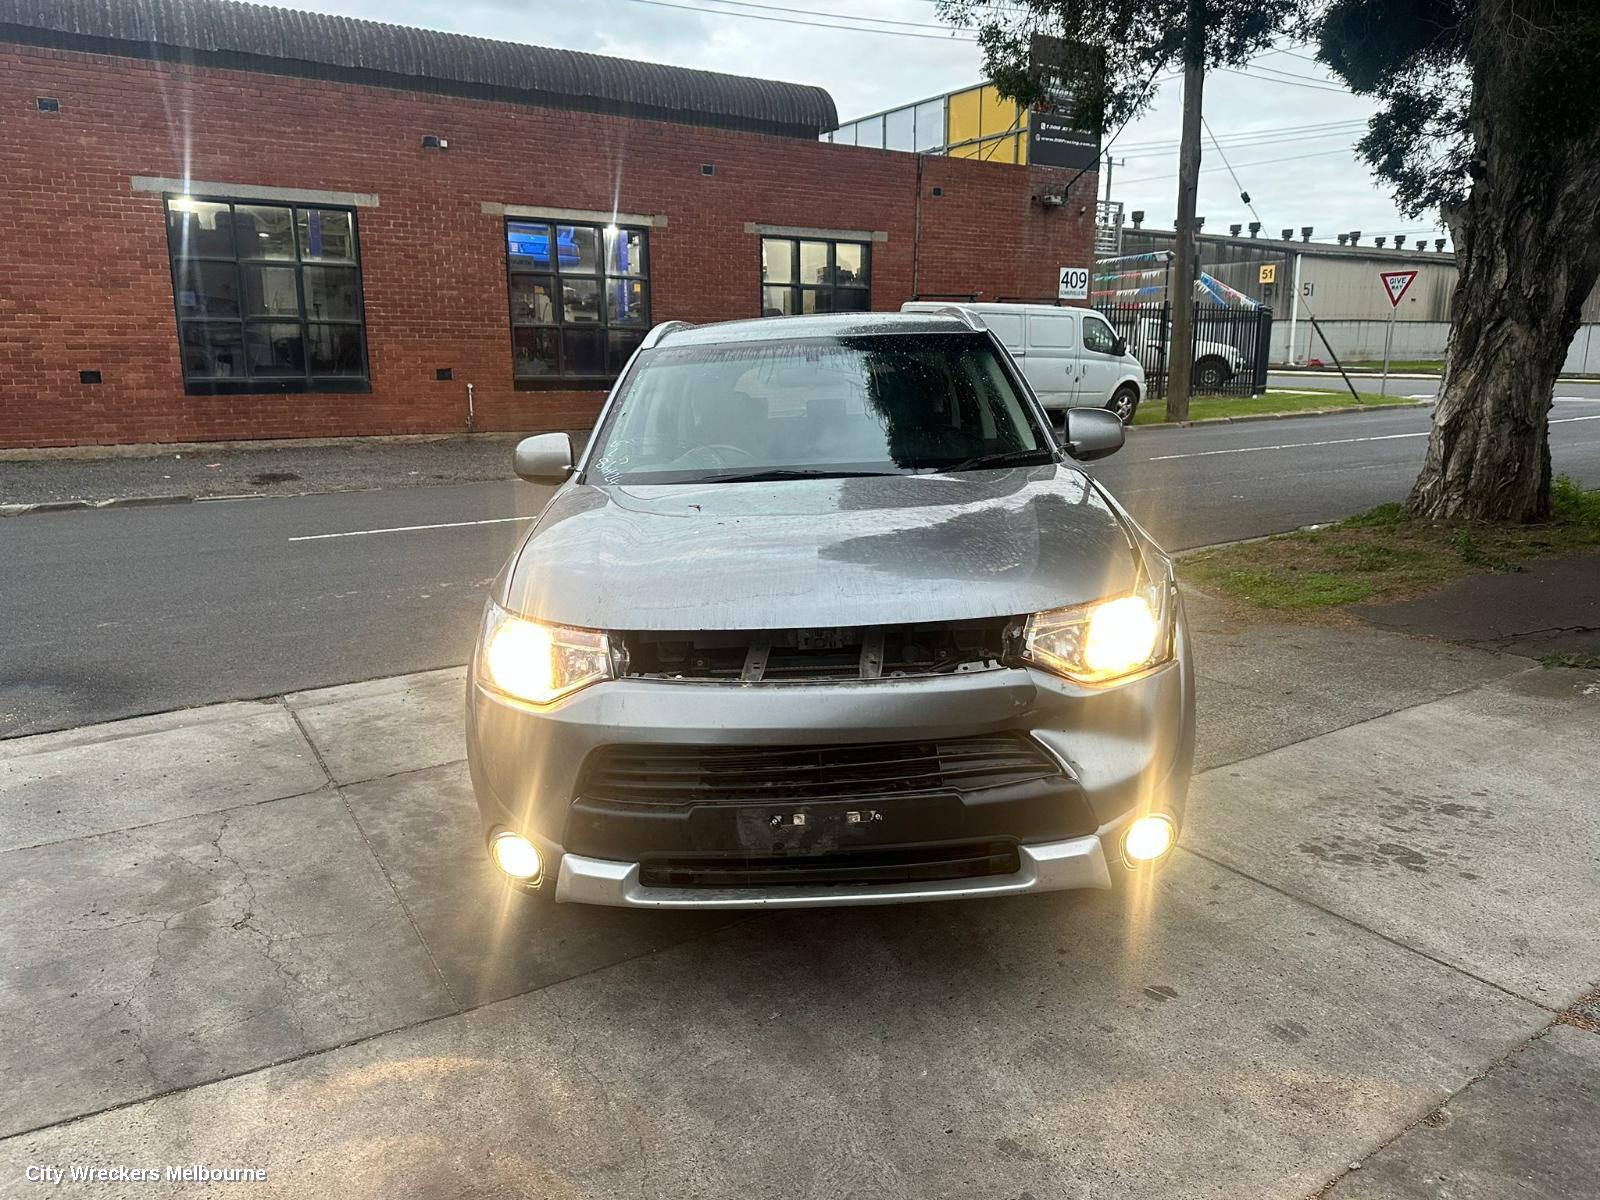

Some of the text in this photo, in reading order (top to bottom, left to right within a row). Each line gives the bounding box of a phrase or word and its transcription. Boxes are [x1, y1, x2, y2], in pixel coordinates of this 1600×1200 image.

[1061, 271, 1087, 289] 409
[1262, 269, 1273, 279] 51
[1303, 282, 1314, 297] 51
